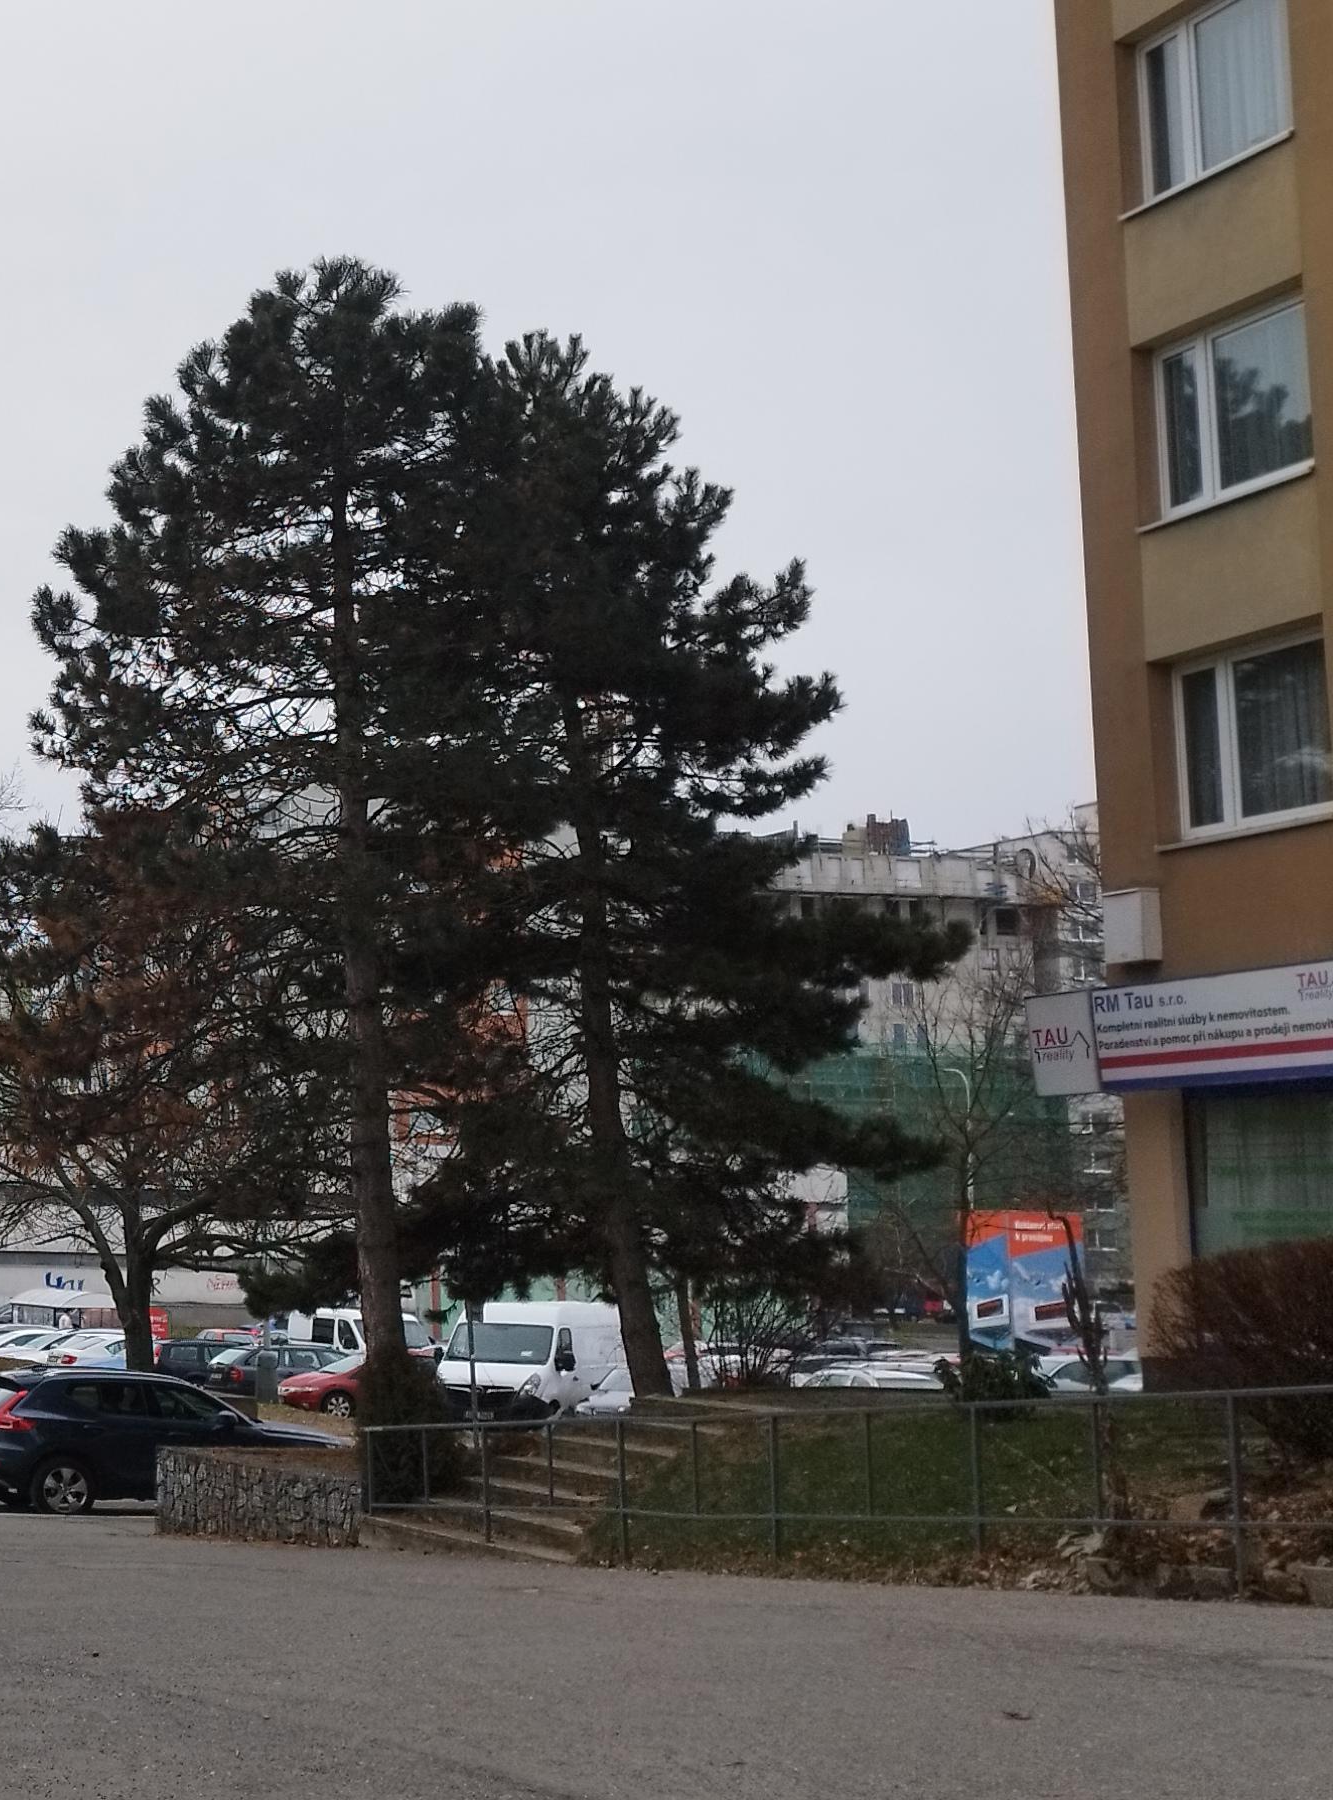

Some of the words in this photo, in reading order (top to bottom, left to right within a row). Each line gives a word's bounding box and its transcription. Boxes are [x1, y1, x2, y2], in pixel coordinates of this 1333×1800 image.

[1297, 970, 1328, 987] TAU
[1095, 994, 1120, 1013] RM
[1124, 992, 1153, 1010] Tau
[1159, 995, 1186, 1007] s.r.o.
[1097, 1019, 1142, 1034] Kompletní
[1144, 1016, 1176, 1029] realitní
[1178, 1012, 1206, 1026] služby
[1209, 1012, 1215, 1022] k
[1032, 1026, 1068, 1046] TAU
[1099, 1036, 1151, 1050] Poradenství
[1160, 1034, 1190, 1047] pomoc
[1193, 1029, 1205, 1045] při
[1208, 1027, 1243, 1041] nákupu
[1255, 1023, 1290, 1039] prodeji
[1042, 1048, 1075, 1062] reality
